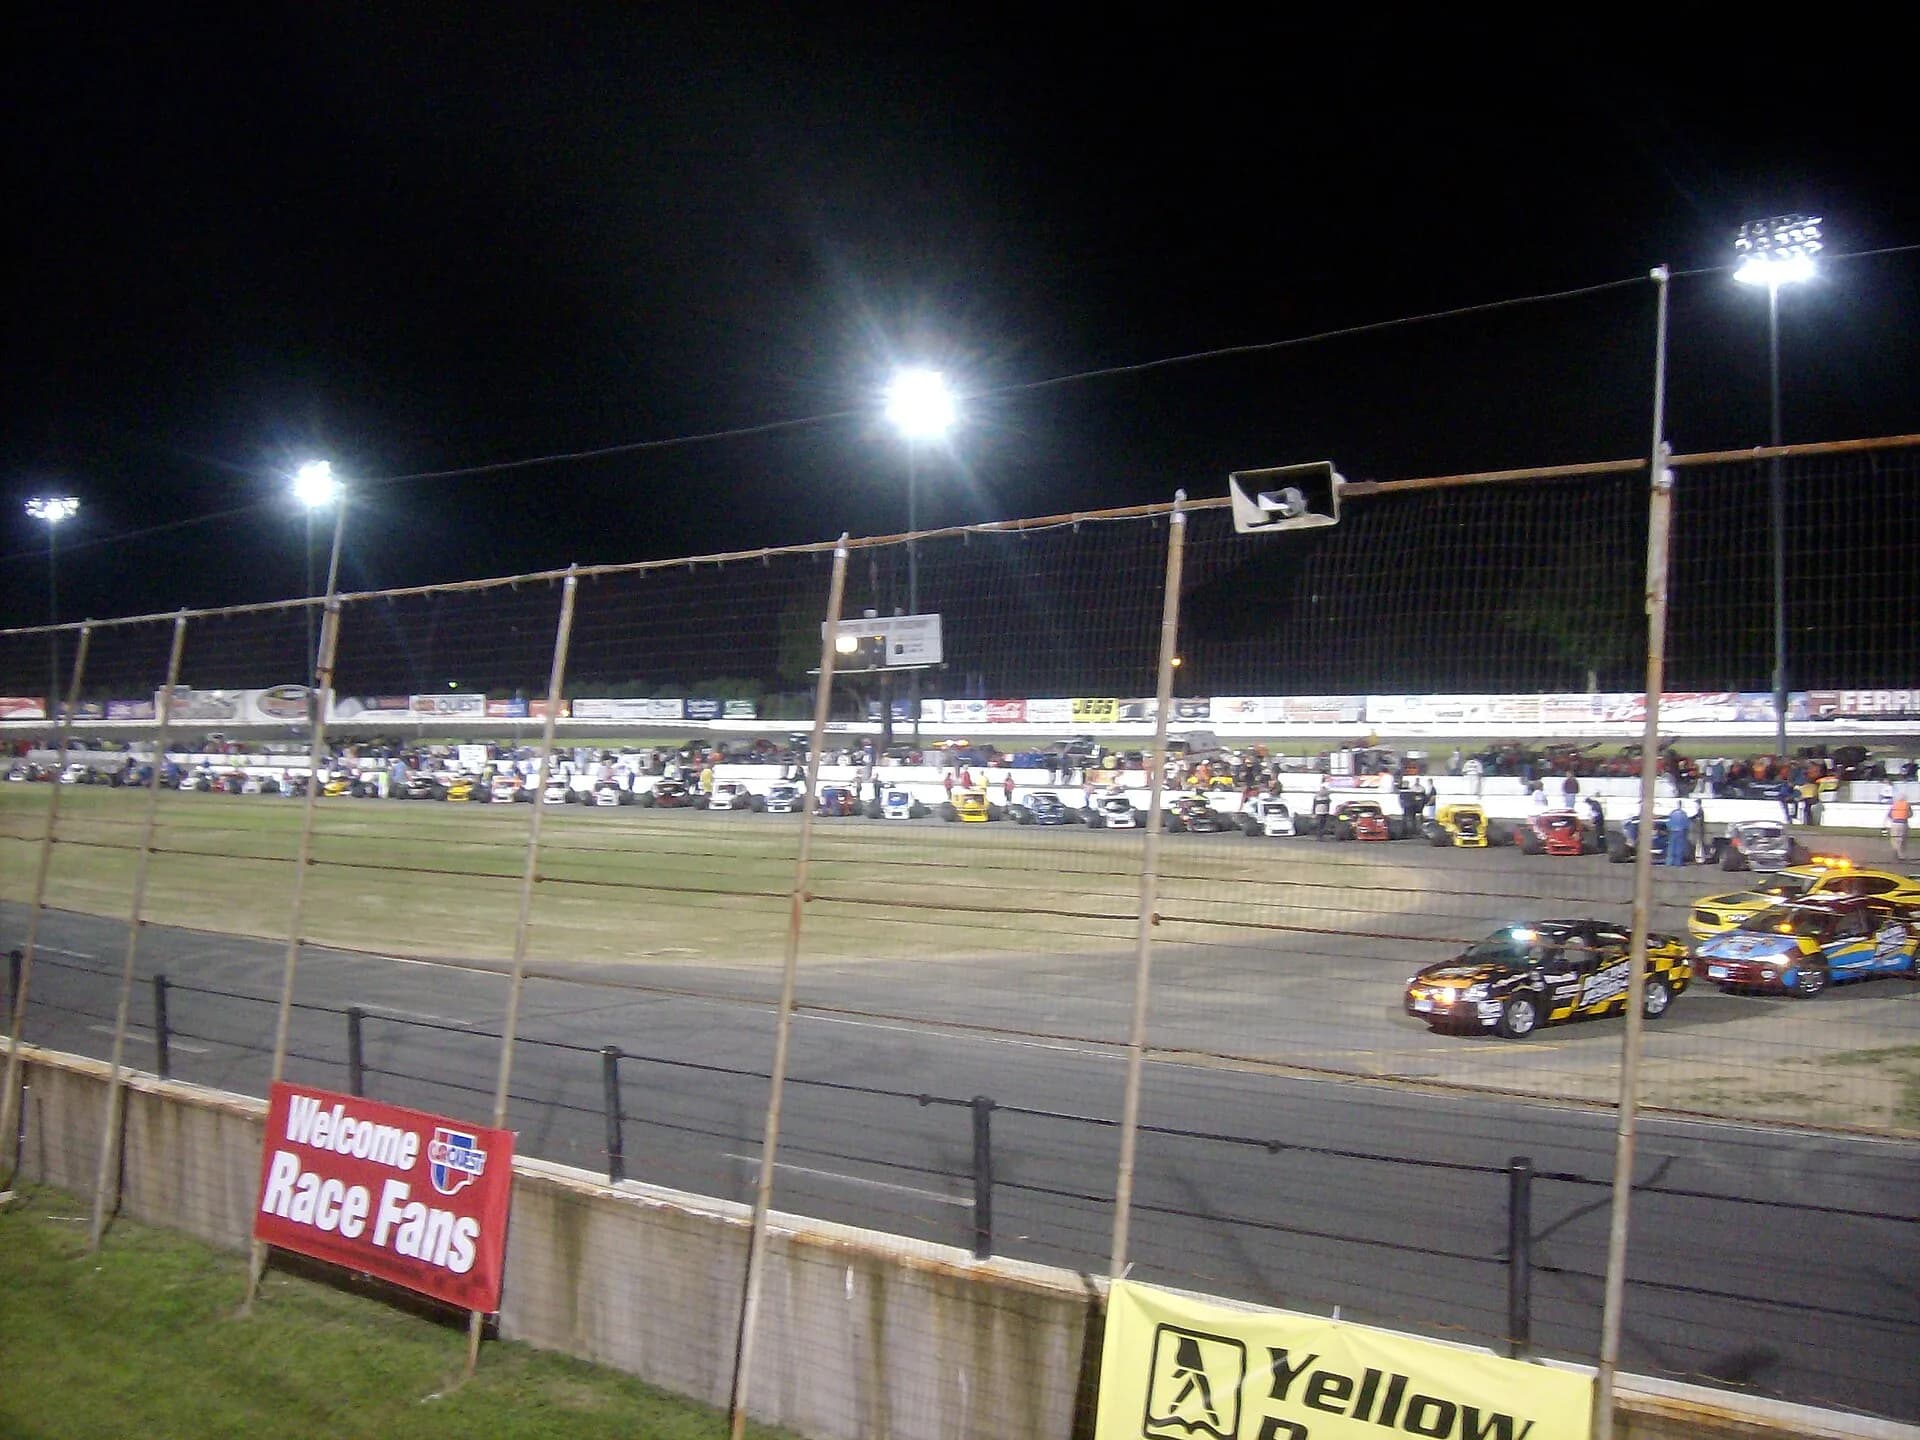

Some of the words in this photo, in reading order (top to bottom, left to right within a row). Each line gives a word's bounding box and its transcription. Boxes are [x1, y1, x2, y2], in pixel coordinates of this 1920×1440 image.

[286, 1094, 420, 1171] Welcome
[261, 1150, 370, 1239] Race
[372, 1178, 480, 1274] Fans
[1266, 1346, 1536, 1440] Yellow
